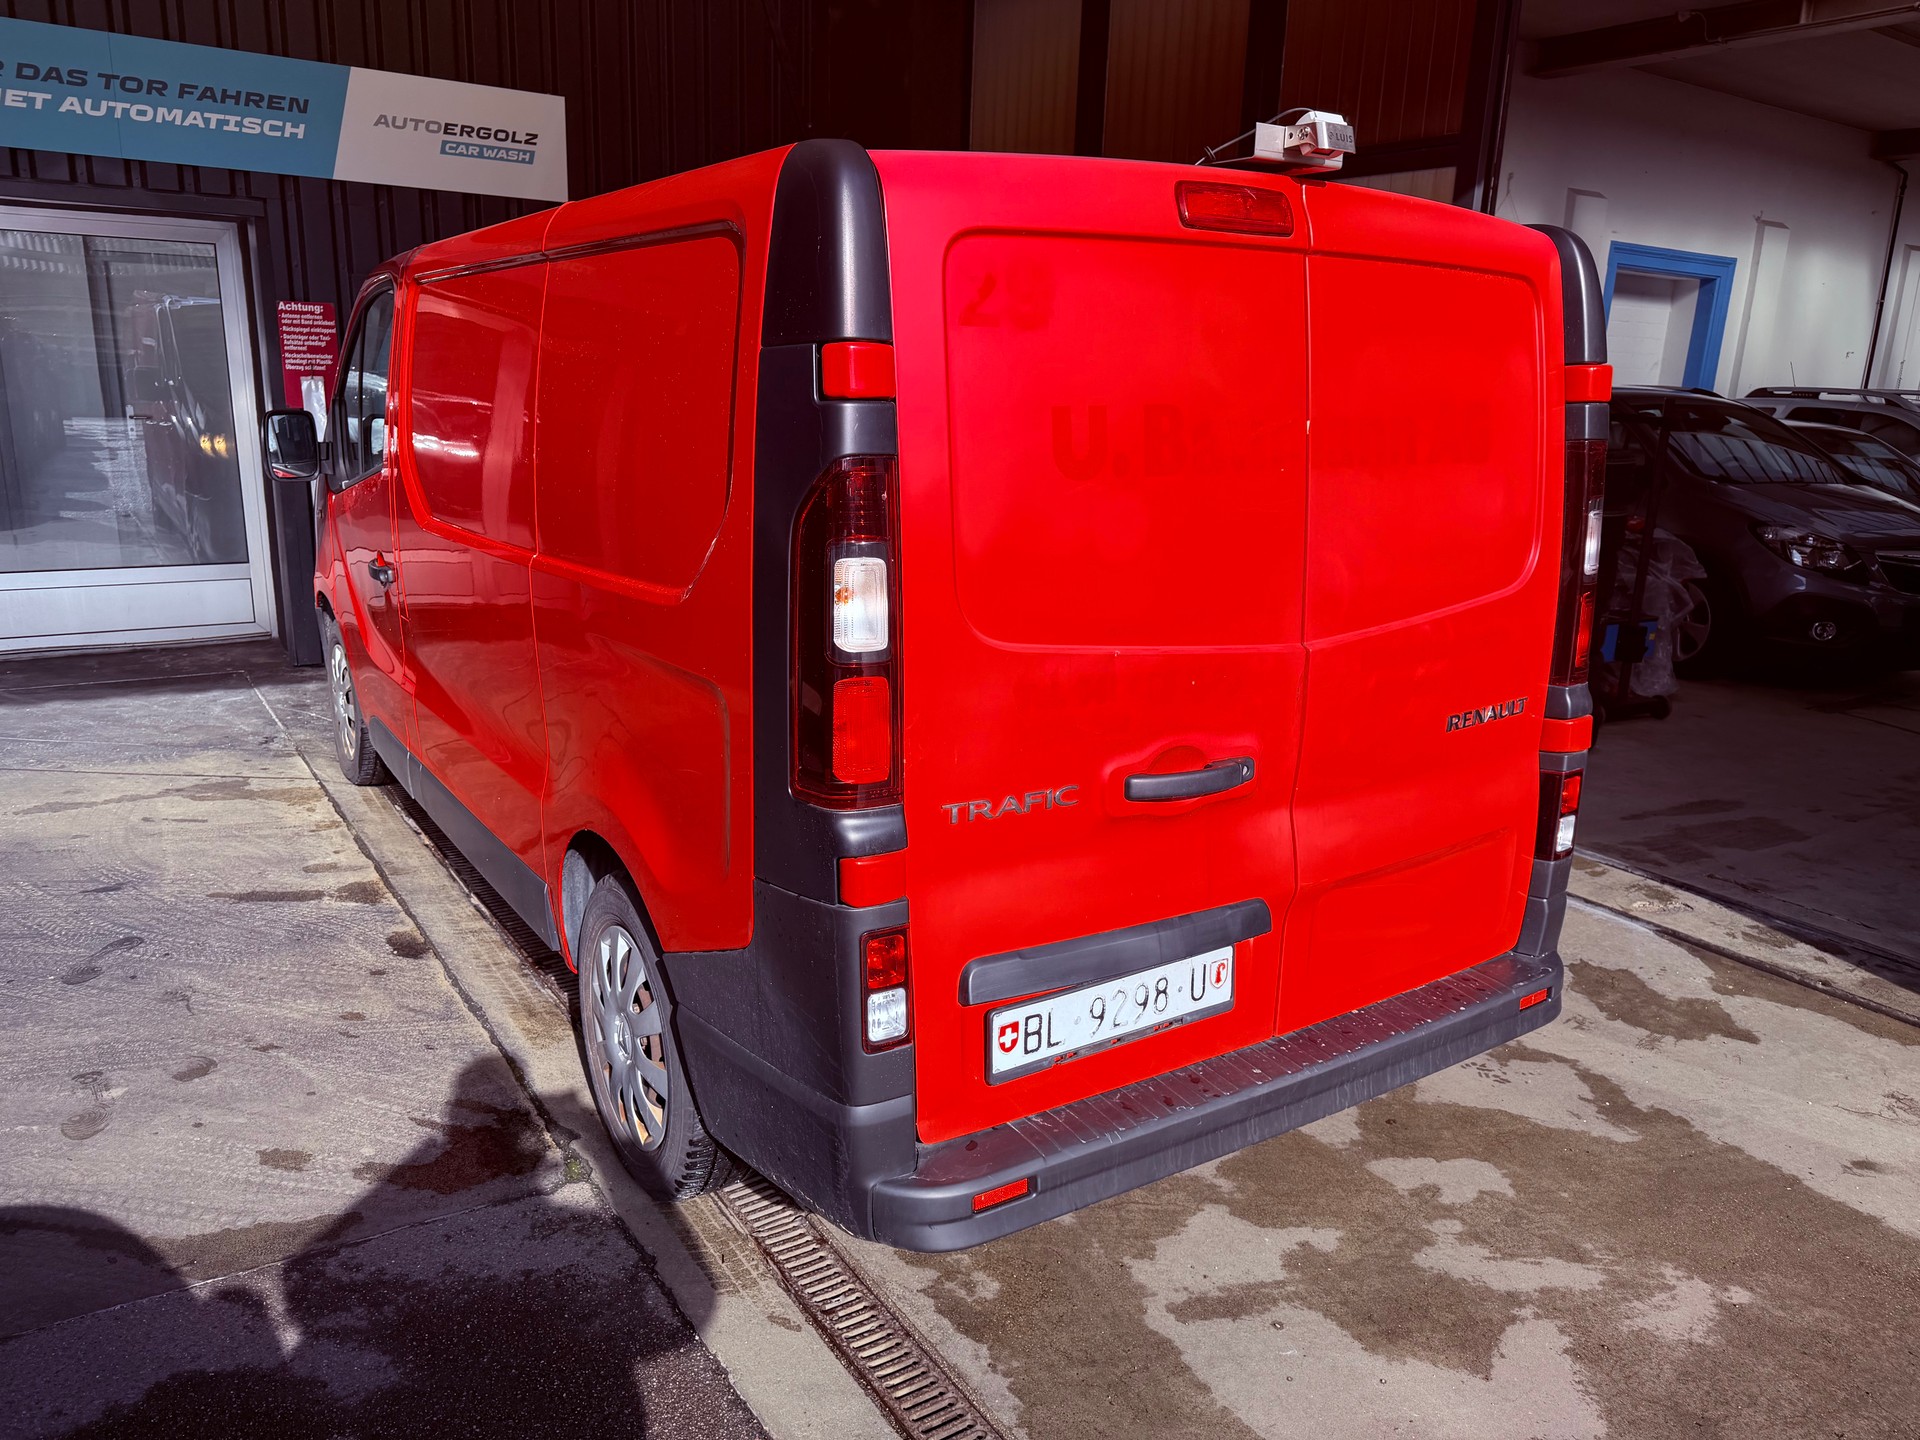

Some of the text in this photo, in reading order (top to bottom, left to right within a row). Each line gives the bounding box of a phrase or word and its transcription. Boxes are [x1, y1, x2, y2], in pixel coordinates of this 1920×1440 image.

[15, 62, 88, 87] DAS
[97, 72, 168, 97] TOR
[178, 83, 310, 114] FAHREN
[0, 88, 306, 139] ET AUTOMATISCH
[373, 114, 539, 146] AUTOERGOLZ
[445, 143, 530, 162] CAR WASH
[1335, 132, 1353, 143] LUIS
[278, 301, 324, 314] Achtung:
[1446, 696, 1529, 733] RENAULT
[941, 784, 1079, 825] TRAFIC
